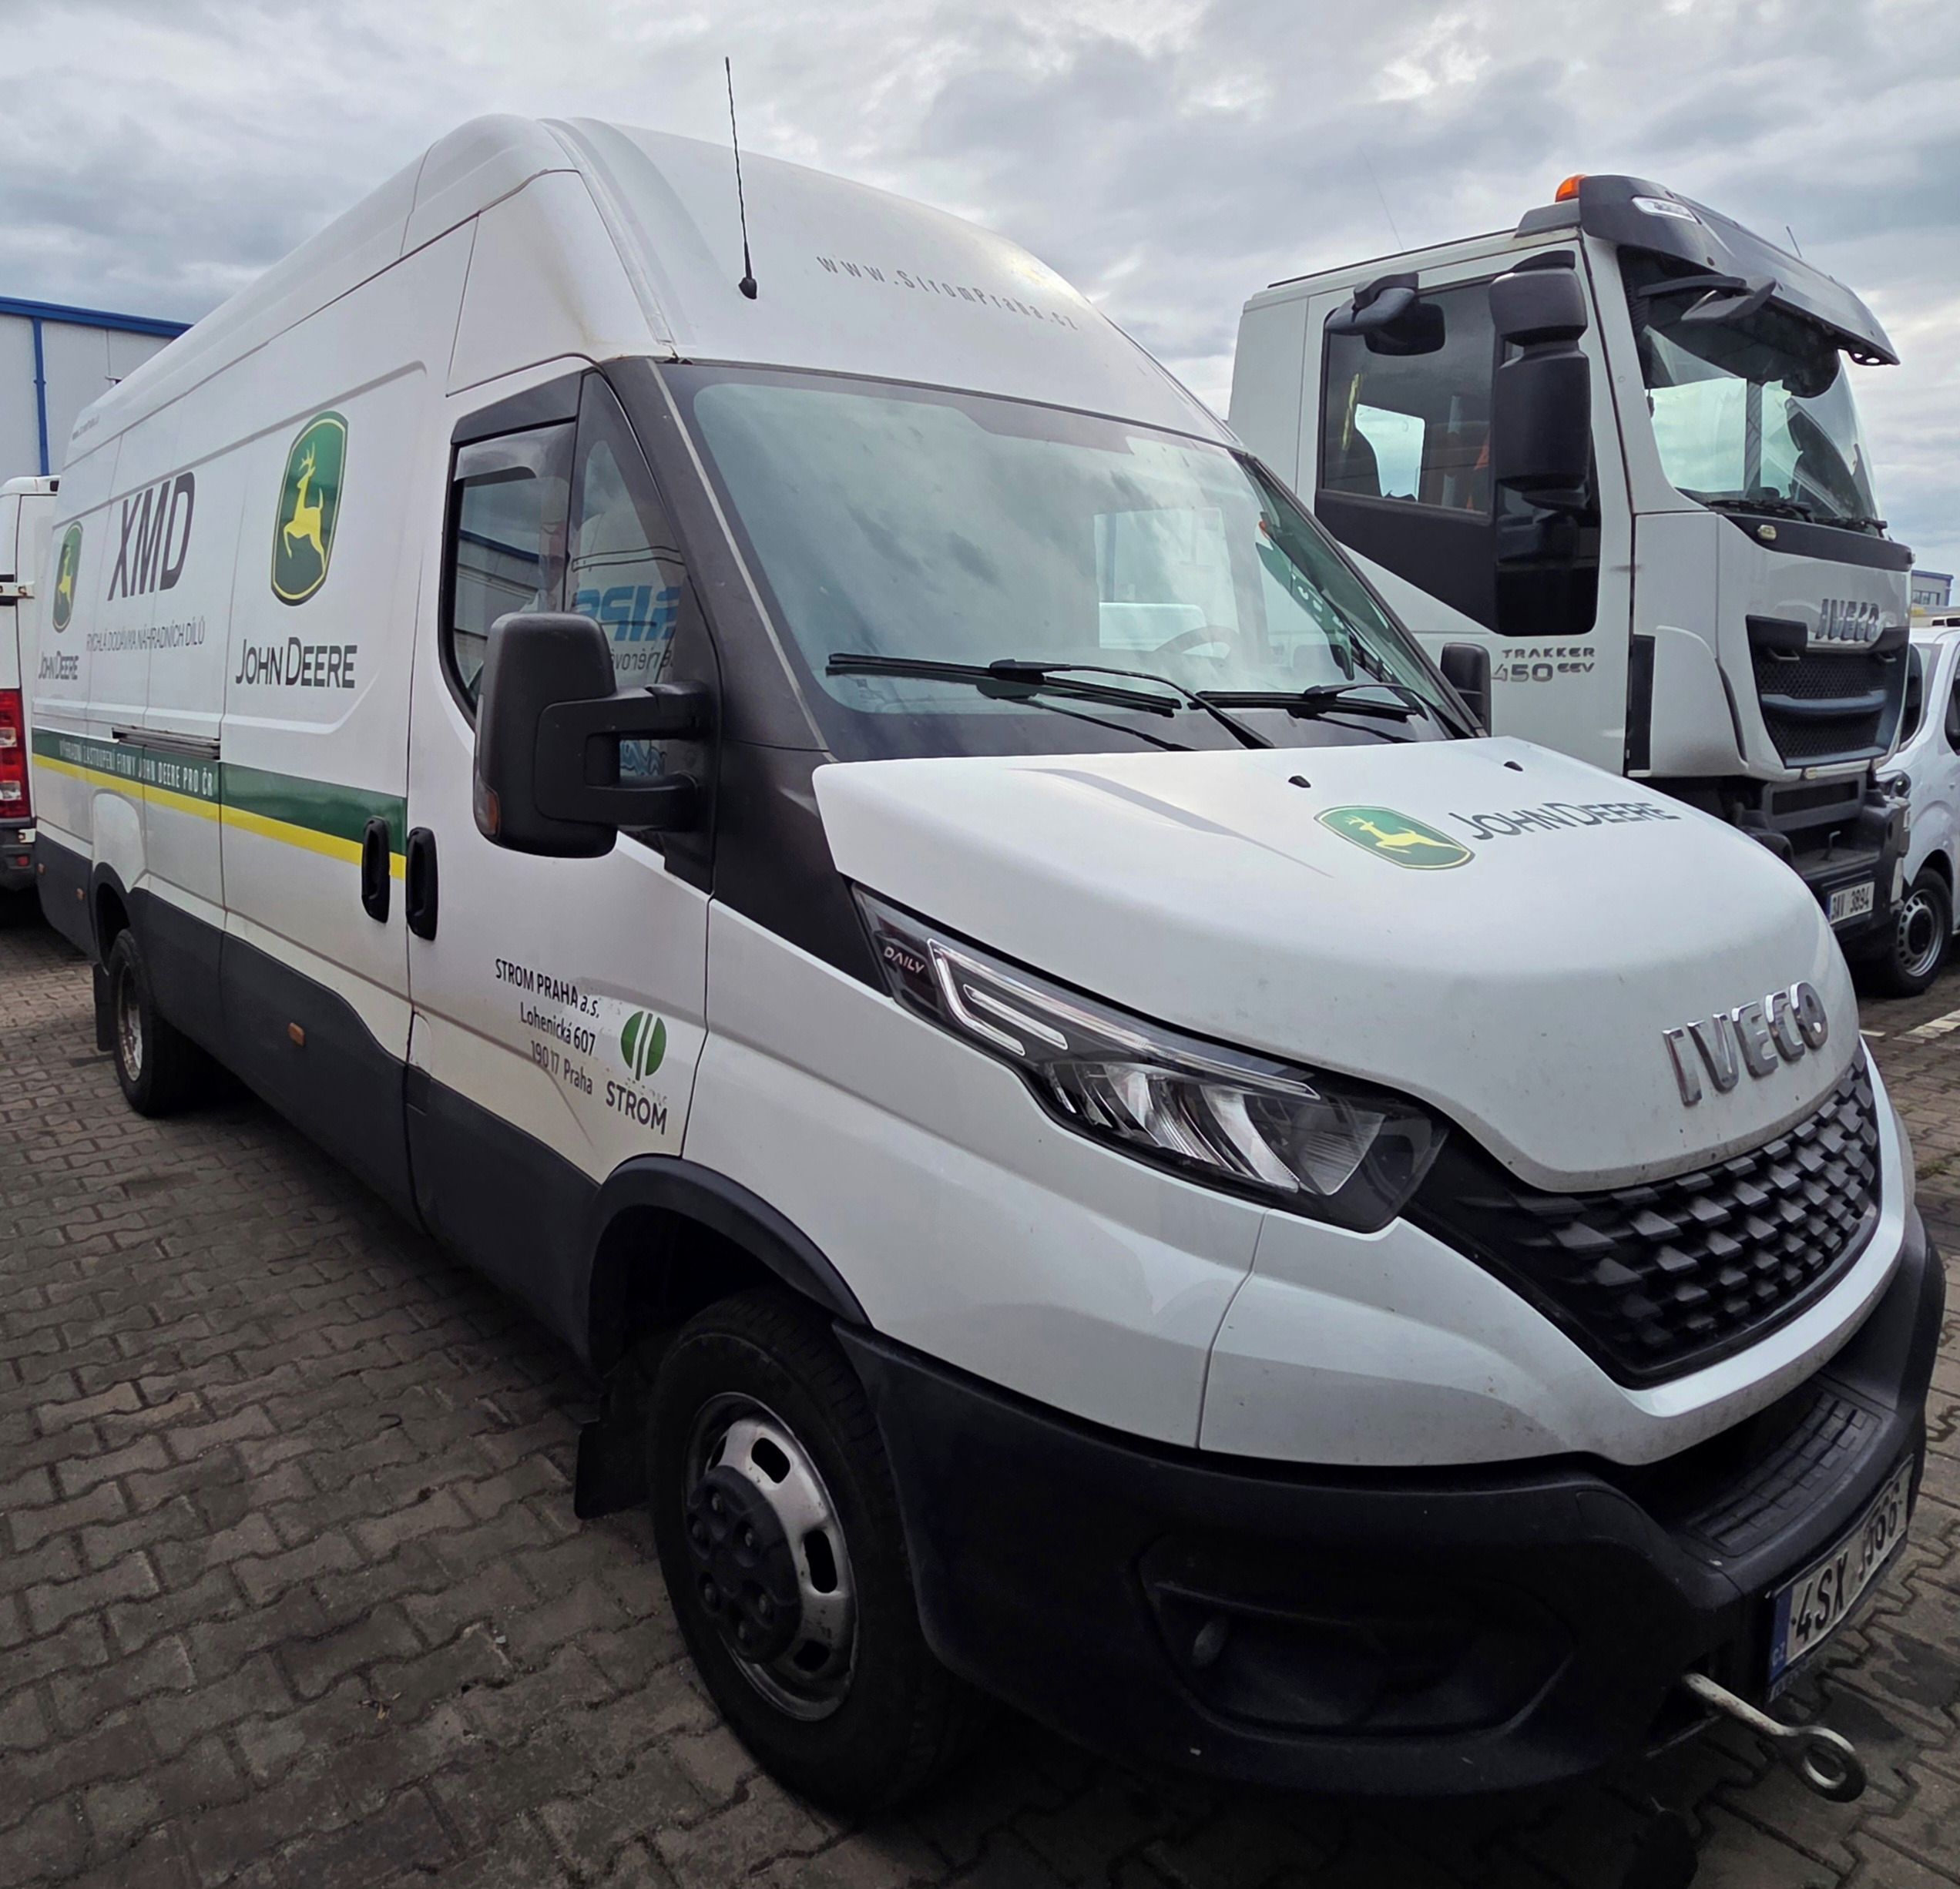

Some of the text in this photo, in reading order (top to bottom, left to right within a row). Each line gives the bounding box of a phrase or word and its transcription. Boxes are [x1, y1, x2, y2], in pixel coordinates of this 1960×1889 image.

[107, 471, 196, 602] XMD
[1815, 599, 1881, 642] IVECO
[55, 650, 79, 680] DEERE
[235, 636, 357, 688] JOHN DEERE
[1492, 663, 1595, 683] 450 EEV
[1502, 647, 1596, 659] TRAKKER
[138, 758, 156, 782] JOHN
[158, 761, 181, 788] DEERE
[183, 767, 200, 793] PRO
[202, 767, 214, 797] ČR
[1448, 802, 1681, 840] JOHN DEERE
[884, 946, 925, 974] DAILY
[495, 958, 599, 1018] STROM PRAHA a.s.
[520, 1002, 596, 1056] Lohenická 607
[1663, 981, 1828, 1107] IVECO
[531, 1040, 593, 1095] 190 17 Praha
[606, 1080, 668, 1136] STROM
[1795, 1550, 1848, 1642] 4SX
